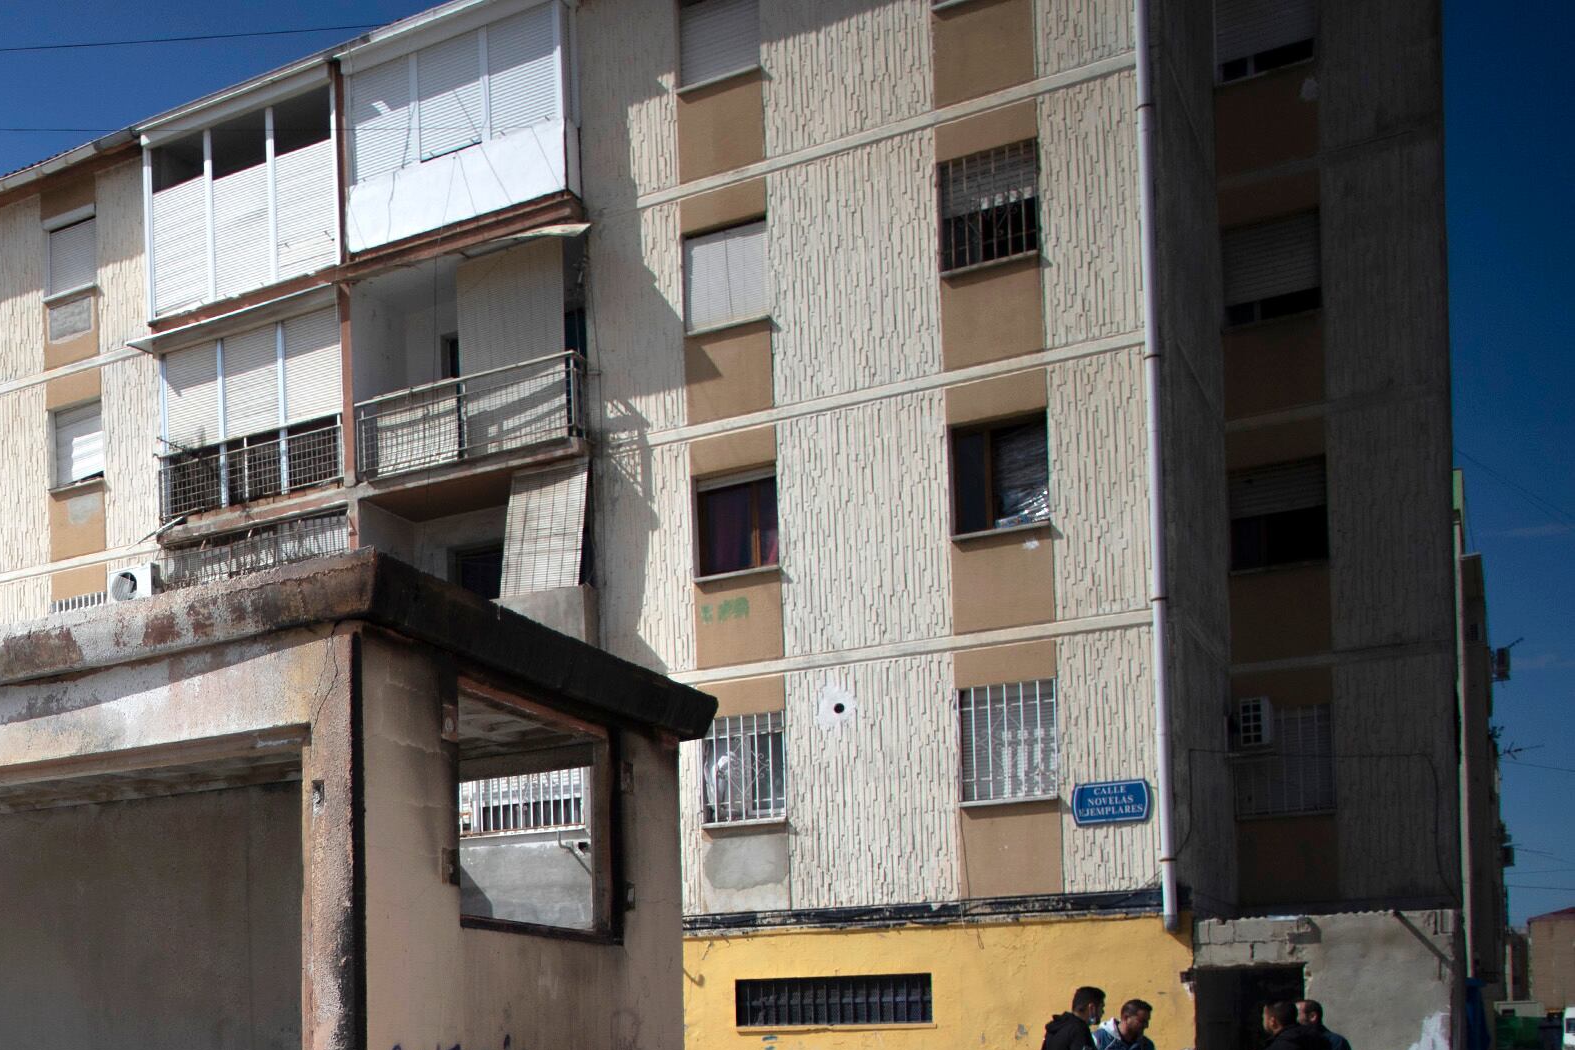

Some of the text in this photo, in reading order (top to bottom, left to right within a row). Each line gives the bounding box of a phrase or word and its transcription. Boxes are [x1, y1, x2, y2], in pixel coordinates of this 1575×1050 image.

[1093, 785, 1126, 796] CALLE
[1088, 795, 1134, 806] NOVELAS
[1080, 804, 1143, 816] EJEMPLARES
